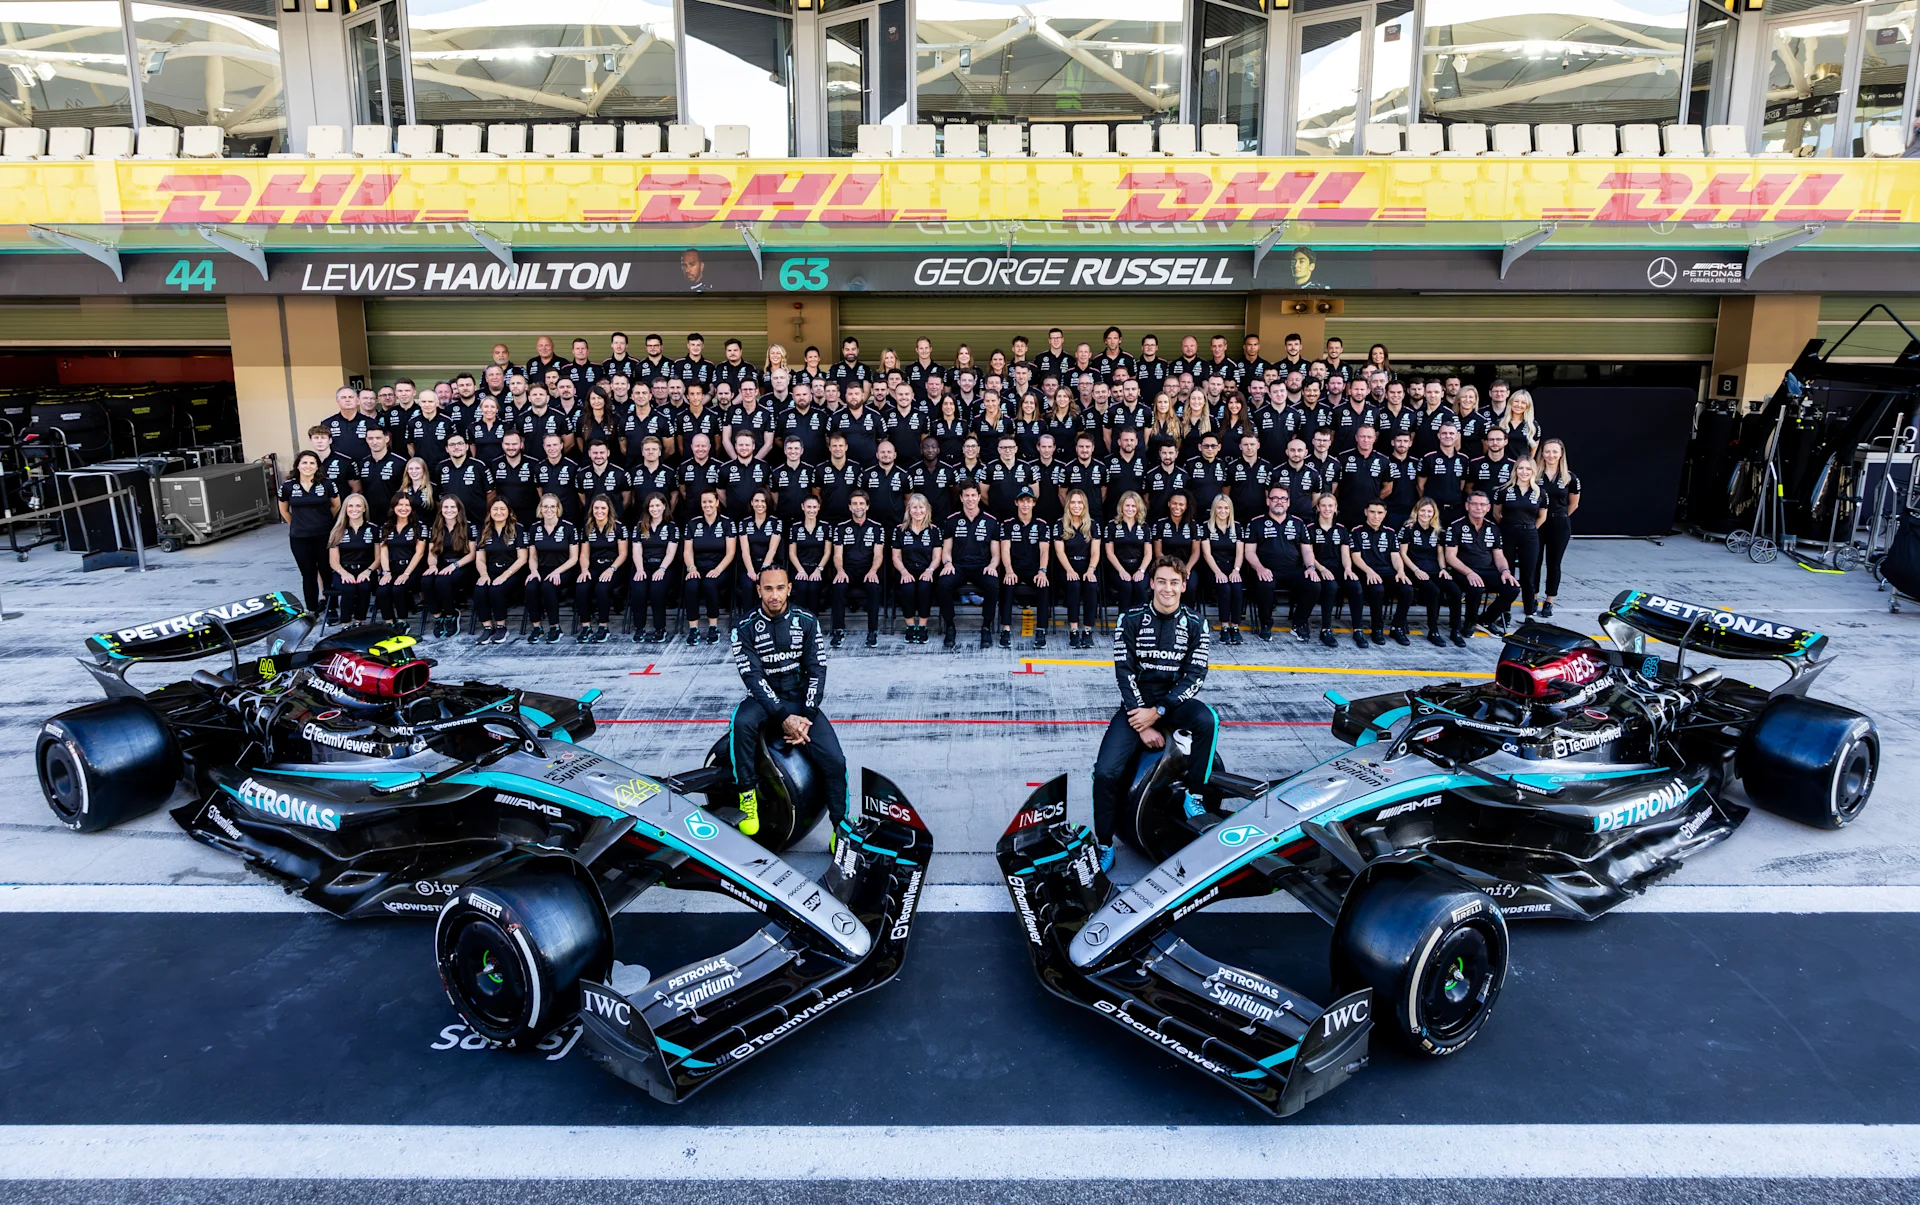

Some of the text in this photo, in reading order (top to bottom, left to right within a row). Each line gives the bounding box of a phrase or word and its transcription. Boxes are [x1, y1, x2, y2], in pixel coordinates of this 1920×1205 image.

[155, 174, 421, 228] DHL
[637, 174, 900, 228] DHL
[1116, 172, 1380, 226] DHL
[1596, 173, 1857, 227] DHL
[165, 260, 216, 291] 44
[301, 262, 631, 291] LEWIS HAMILTON
[779, 258, 829, 291] 63
[914, 258, 1233, 286] GEORGE RUSSELL
[1723, 380, 1731, 391] 8
[258, 658, 276, 679] 44
[1136, 650, 1186, 660] PETRONAS
[1642, 655, 1660, 677] 63
[327, 653, 365, 686] INEOS
[312, 678, 340, 696] SOLERA
[805, 677, 819, 707] INEOS
[1178, 678, 1204, 702] INEOS
[1584, 677, 1611, 696] SOLERA
[435, 717, 477, 730] CROWDSTRIKE
[1457, 719, 1500, 732] CROWDSTRIKE
[314, 727, 376, 753] TeamViewer
[1502, 742, 1518, 753] G42
[1566, 726, 1622, 753] TeamViewer
[543, 754, 591, 779] PETRONAS
[551, 757, 602, 785] Syntium
[1328, 760, 1382, 787] Syntium
[1340, 757, 1391, 783] PETRONAS
[389, 780, 419, 793] PETRONAS
[614, 778, 661, 809] 44
[1517, 783, 1547, 795] PETRONAS
[238, 777, 337, 832] PETRONAS
[512, 798, 562, 818] AMG
[865, 796, 911, 822] INEOS
[1019, 801, 1064, 828] INEOS
[1394, 795, 1442, 816] AMG
[1594, 777, 1689, 833] PETRONAS
[720, 879, 768, 912] Einhell
[804, 893, 821, 912] SAP
[895, 871, 923, 924] TeamViewer
[1172, 886, 1219, 921] Einhell
[1481, 884, 1520, 898] nify
[469, 893, 503, 919] PIRELLI
[1013, 881, 1042, 946] TeamViewer
[1113, 900, 1132, 914] SAP
[1451, 900, 1482, 923] PIRELLI
[1500, 904, 1552, 914] WDSTRIKE
[668, 957, 727, 989] PETRONAS
[1217, 966, 1279, 999] PETRONAS
[674, 974, 735, 1012] Syntium
[1209, 981, 1274, 1021] Syntium
[583, 990, 631, 1026] IWC
[753, 987, 853, 1046] TeamViewer
[1322, 1000, 1368, 1038] IWC
[1115, 1009, 1226, 1074] TeamViewer
